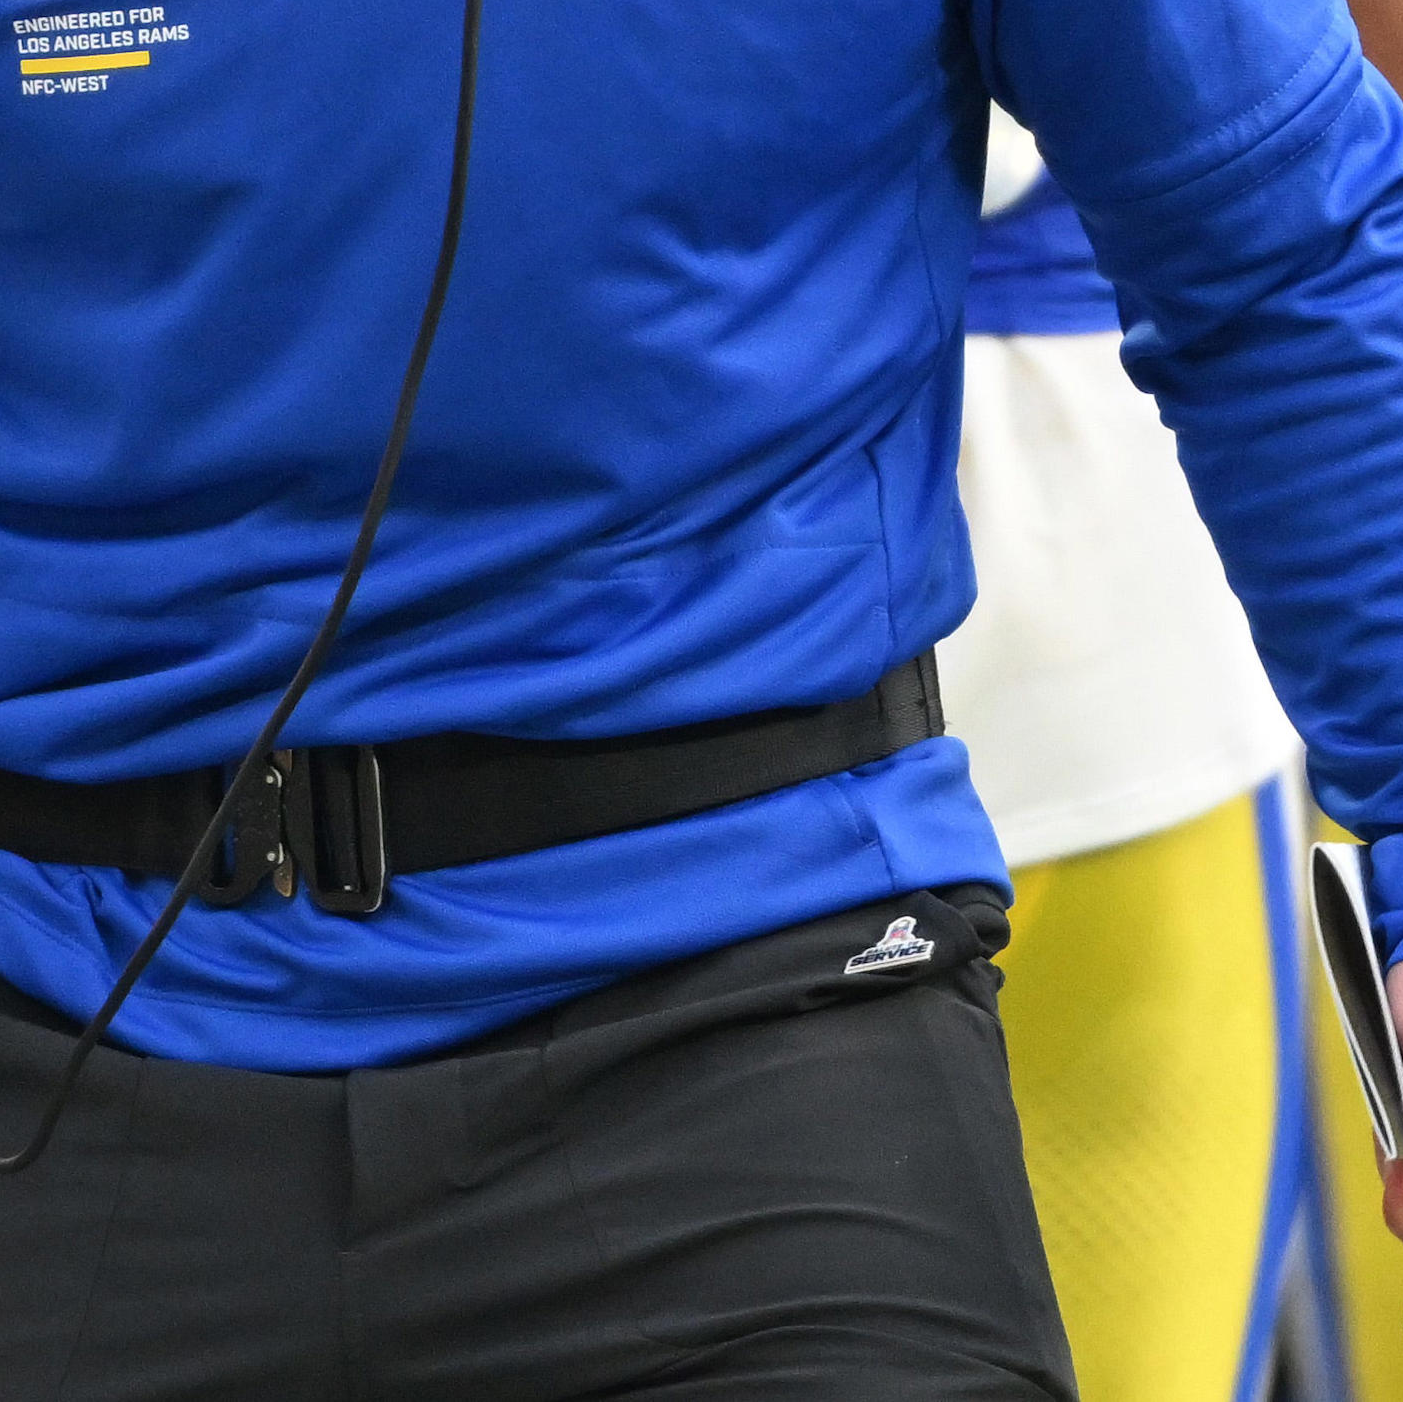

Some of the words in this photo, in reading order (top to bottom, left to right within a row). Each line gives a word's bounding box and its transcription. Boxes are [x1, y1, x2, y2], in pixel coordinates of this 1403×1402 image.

[13, 10, 125, 35] ENGINEERED
[129, 6, 165, 25] FOR
[18, 36, 50, 55] LOS
[54, 30, 134, 52] ANGELES
[138, 24, 190, 45] RAMS
[21, 74, 109, 96] NFC-WEST
[850, 941, 930, 967] SERVICE
